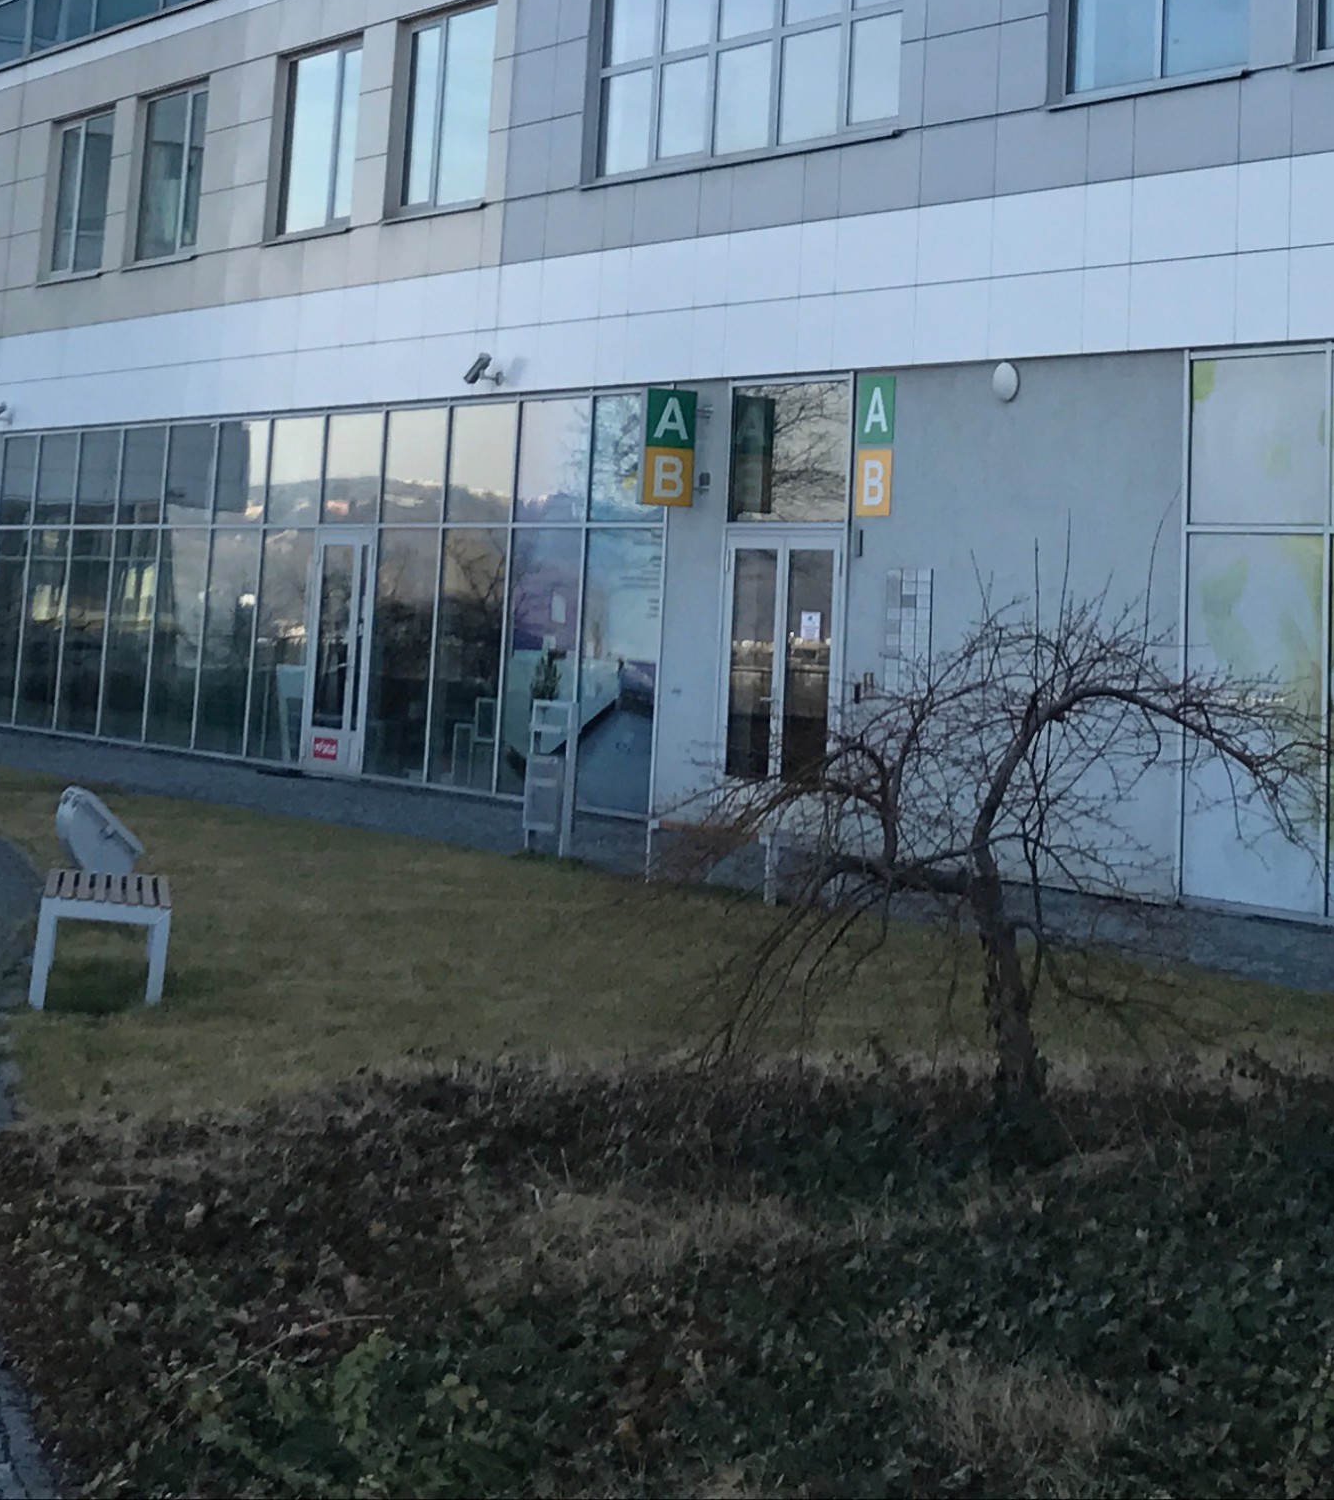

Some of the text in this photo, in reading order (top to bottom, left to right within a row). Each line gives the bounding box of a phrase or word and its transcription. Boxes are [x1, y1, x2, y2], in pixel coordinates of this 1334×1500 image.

[653, 397, 688, 440] A
[863, 387, 888, 433] A
[653, 455, 684, 498] B
[863, 459, 884, 506] B
